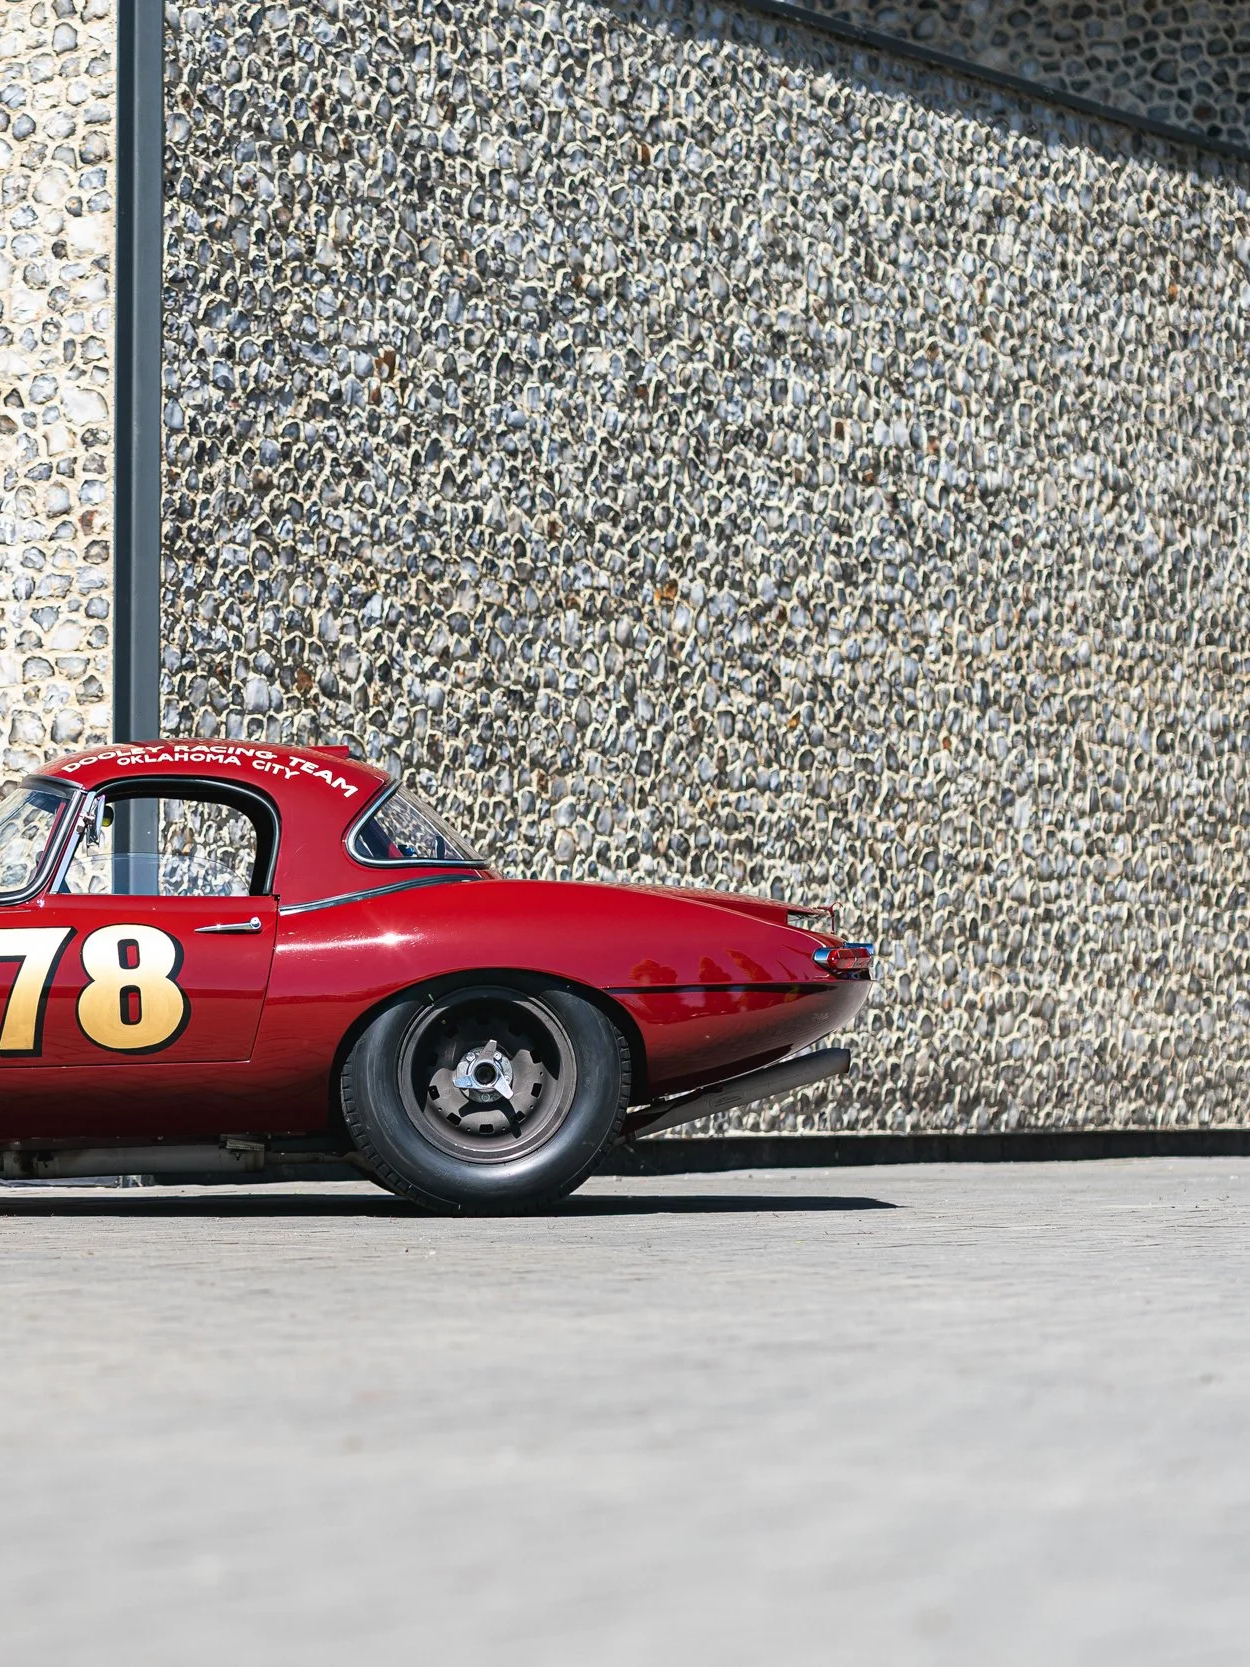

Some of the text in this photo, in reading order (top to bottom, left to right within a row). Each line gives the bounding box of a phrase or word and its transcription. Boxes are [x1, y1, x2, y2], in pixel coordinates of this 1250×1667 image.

[61, 744, 359, 798] DOOLEY RACING TEAM
[116, 752, 301, 780] OKLAHOMA CITY
